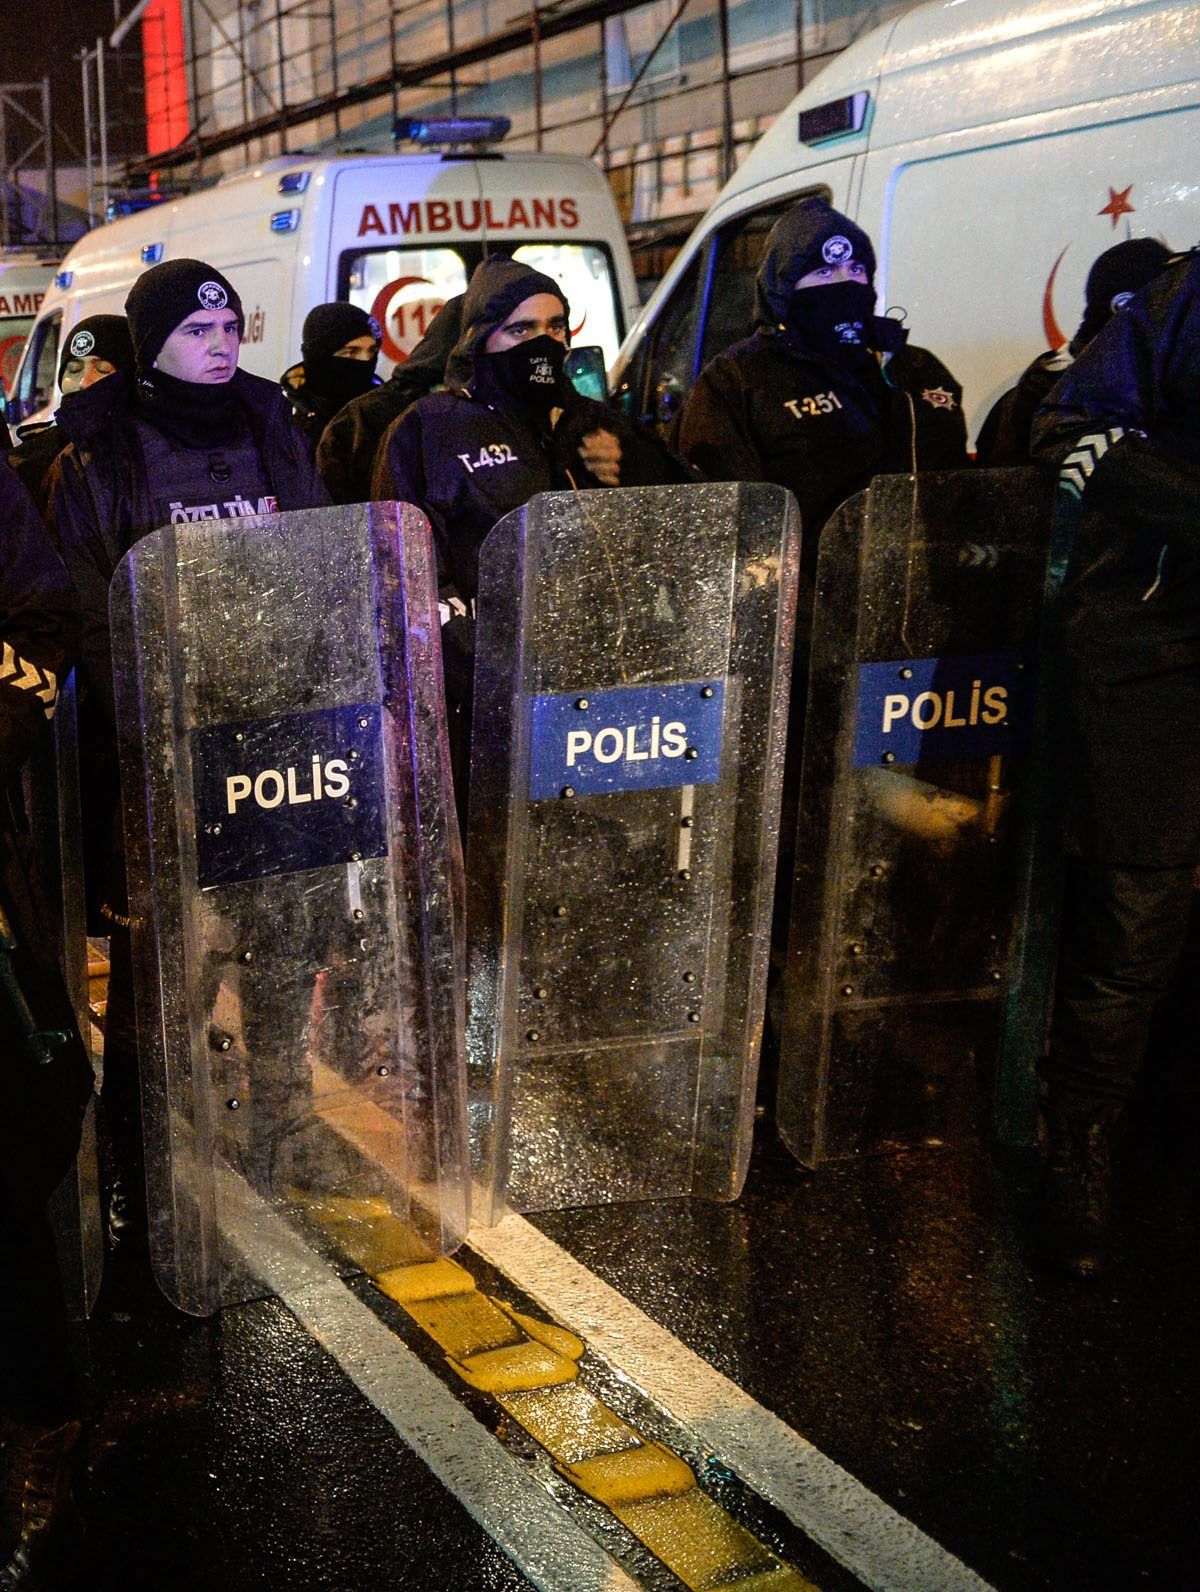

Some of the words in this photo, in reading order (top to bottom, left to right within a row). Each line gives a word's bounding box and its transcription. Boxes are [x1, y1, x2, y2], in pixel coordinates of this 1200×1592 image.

[357, 197, 580, 237] AMBULANS
[784, 391, 842, 419] T-251
[457, 443, 518, 473] T-432
[882, 680, 1008, 733] POLİS
[566, 716, 687, 767] POLİS
[227, 754, 350, 814] POLİS
